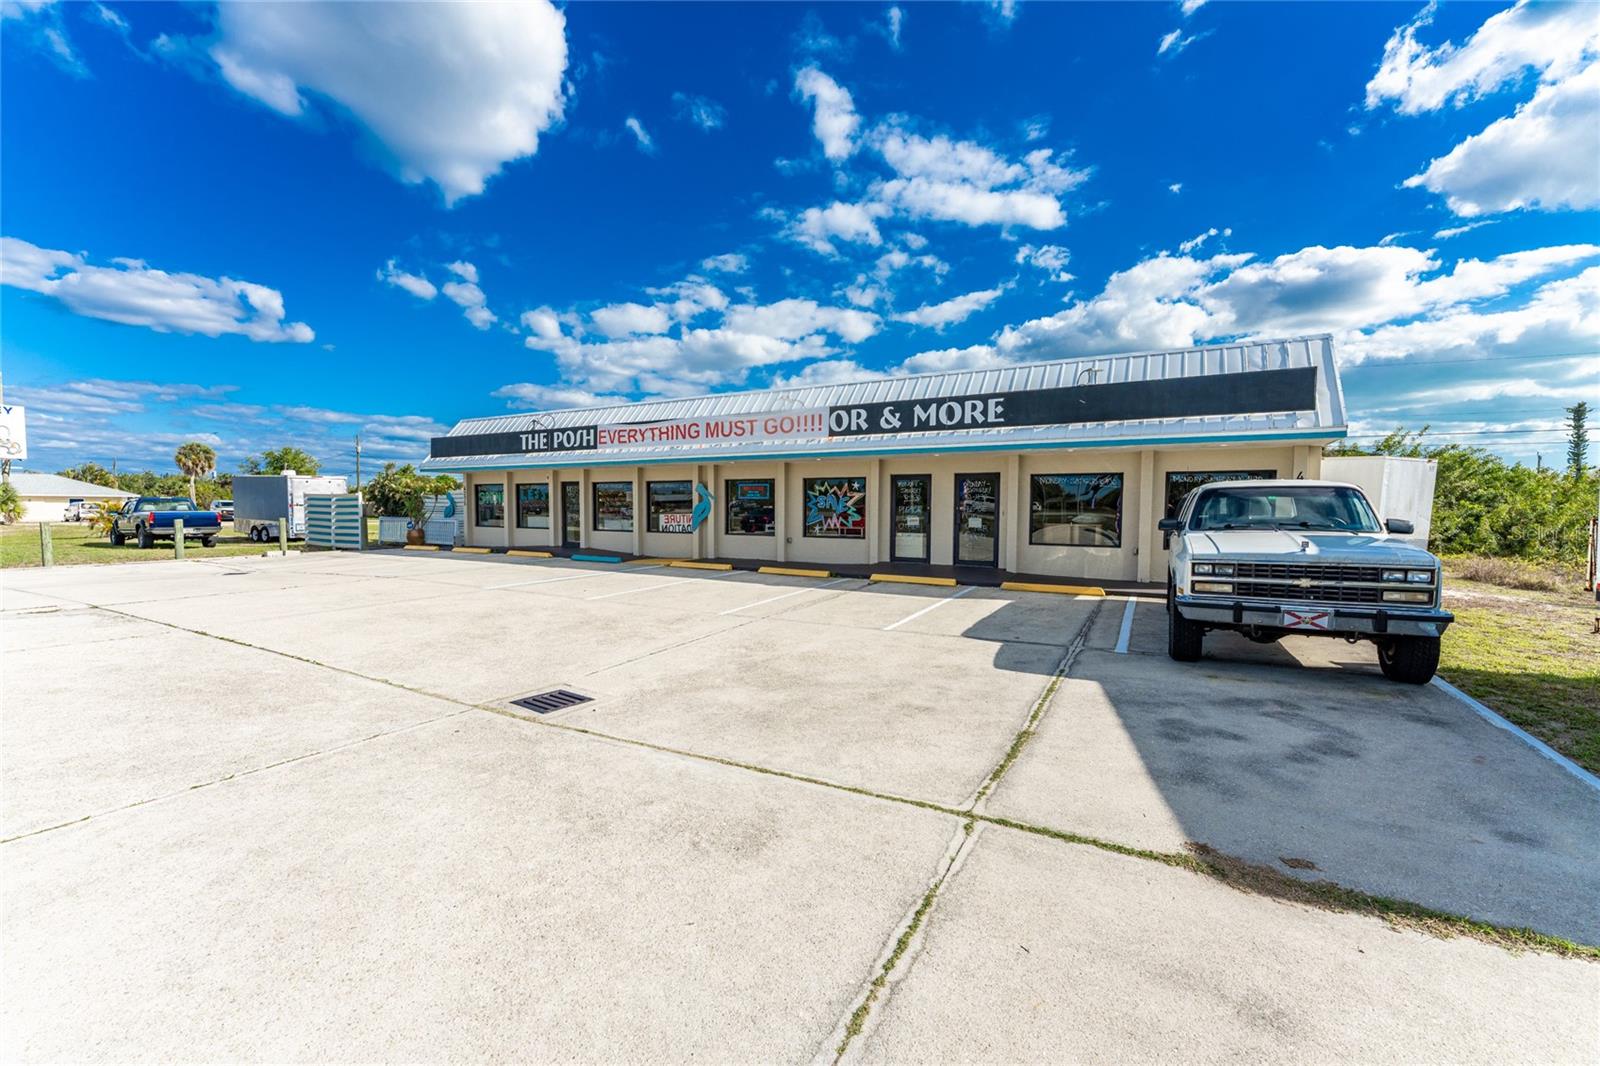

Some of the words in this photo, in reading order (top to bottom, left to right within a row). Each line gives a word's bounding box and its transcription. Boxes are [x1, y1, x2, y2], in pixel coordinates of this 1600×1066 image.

[598, 421, 700, 445] EVERYTHING
[705, 419, 758, 439] MUST
[764, 413, 823, 435] GO!!!!
[880, 406, 902, 429] &
[913, 397, 1006, 428] MORE
[520, 432, 548, 451] THE
[553, 428, 595, 449] POSH
